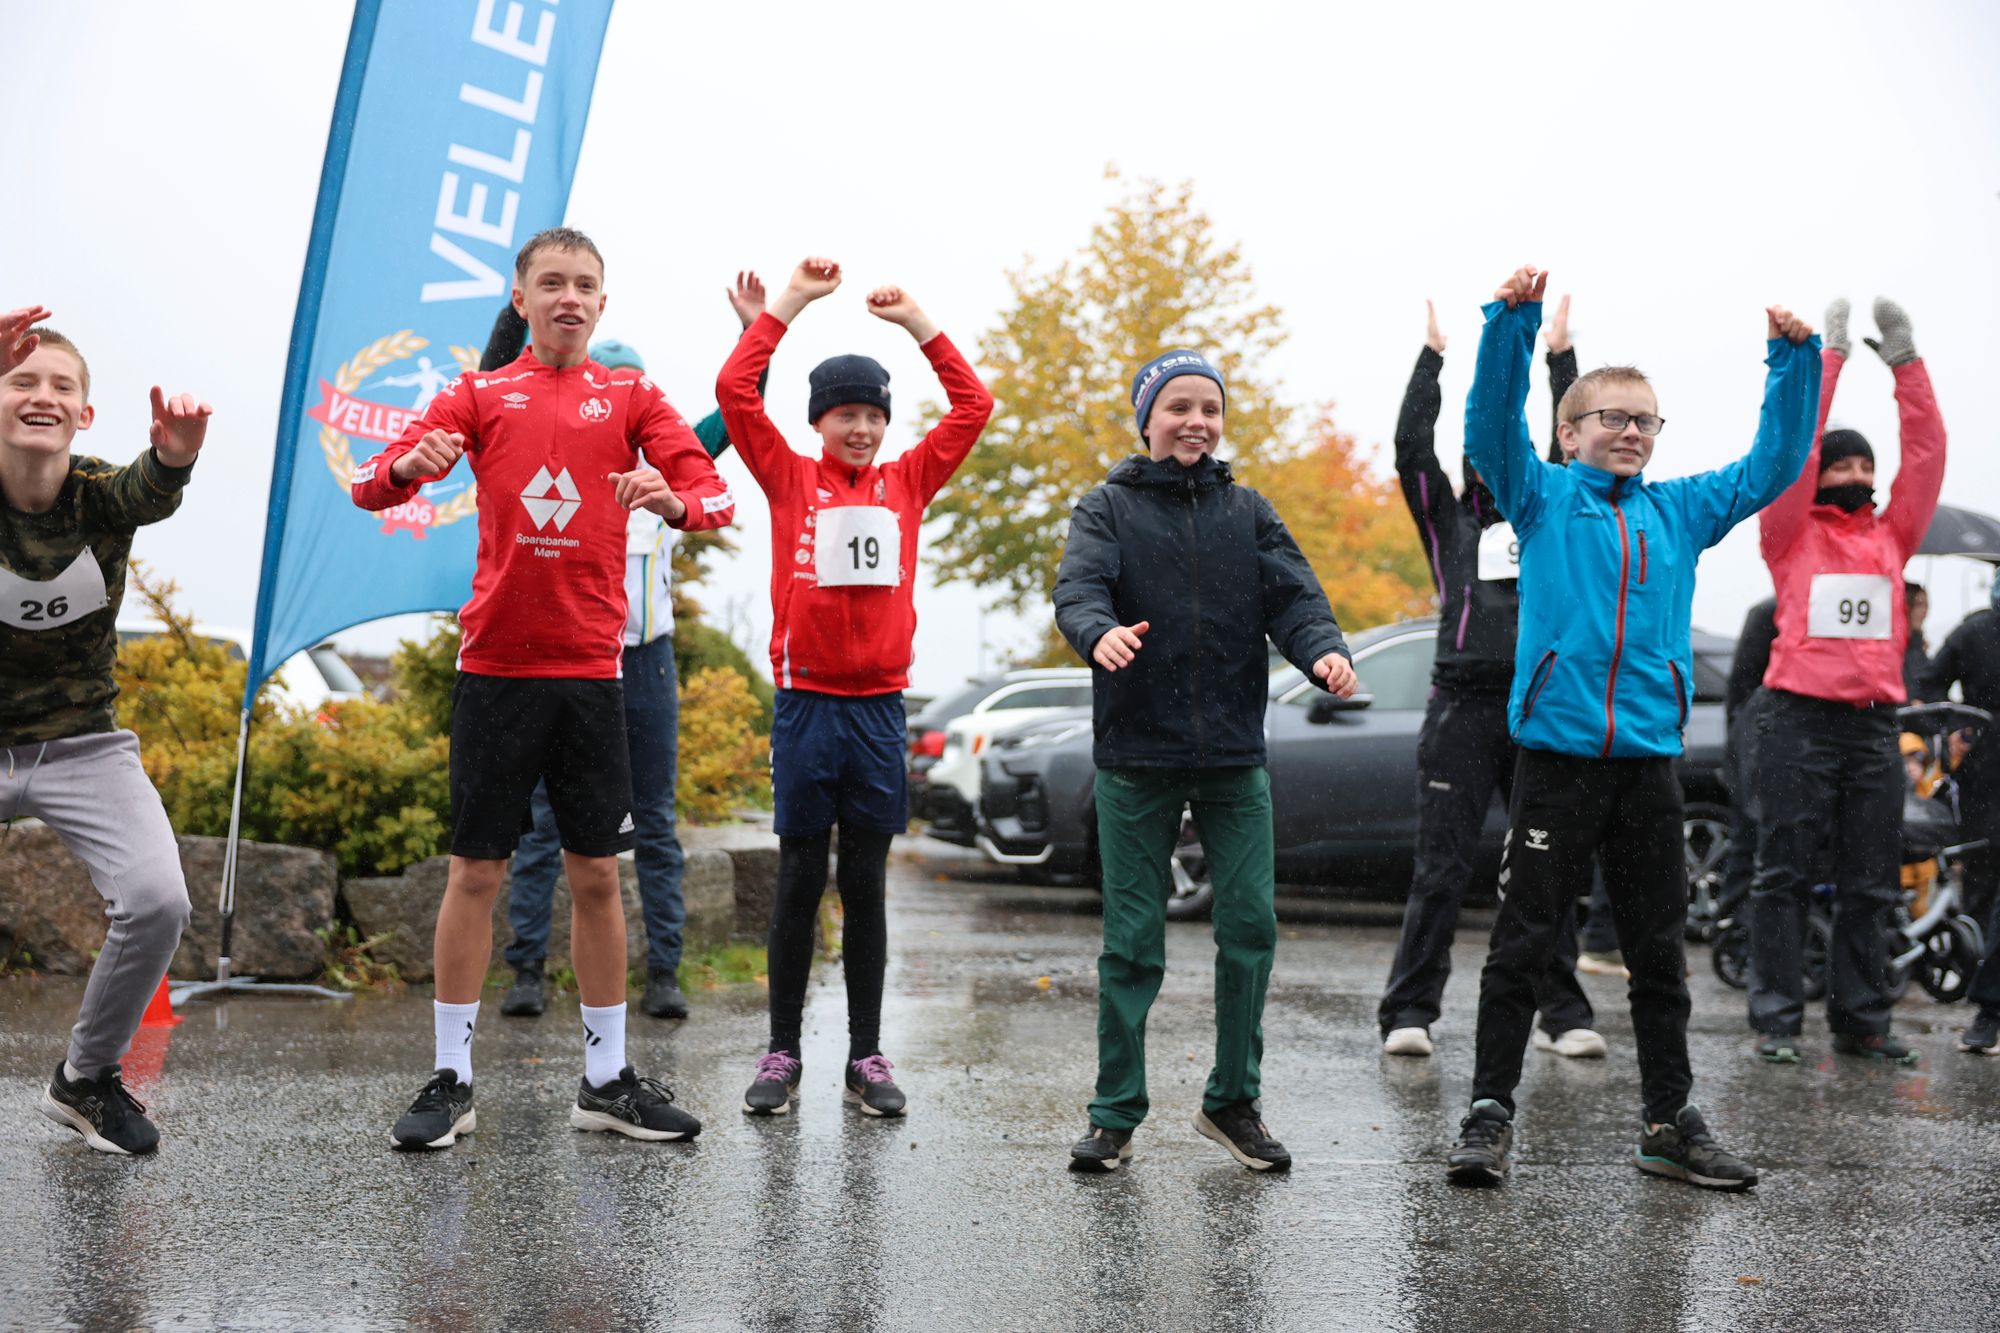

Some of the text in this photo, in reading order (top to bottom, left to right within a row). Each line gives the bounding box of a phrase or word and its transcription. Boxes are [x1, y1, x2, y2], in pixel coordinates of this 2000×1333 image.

[420, 0, 559, 303] VELLE
[504, 402, 527, 410] umbro
[383, 501, 433, 525] 1906
[515, 533, 580, 548] Sparebanken
[534, 547, 561, 558] Møre
[847, 536, 879, 570] 19
[20, 596, 68, 621] 26
[1839, 599, 1870, 625] 99
